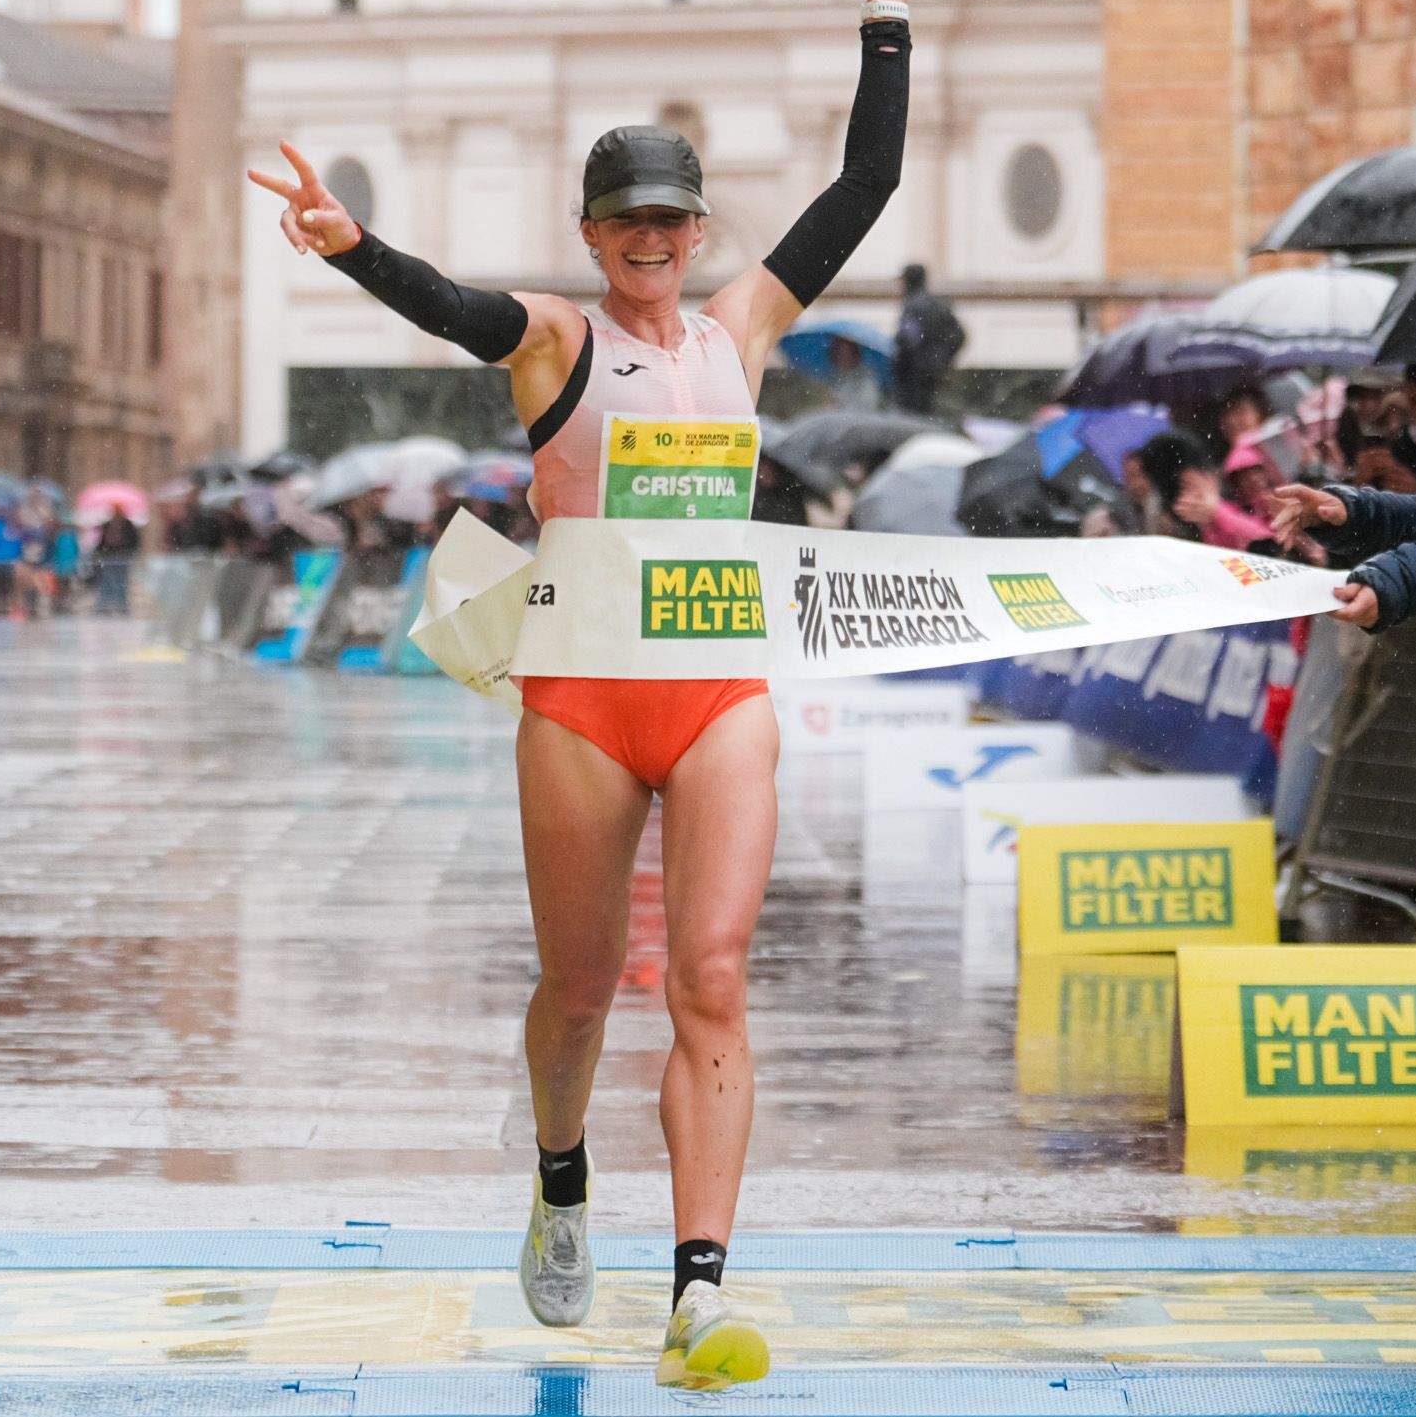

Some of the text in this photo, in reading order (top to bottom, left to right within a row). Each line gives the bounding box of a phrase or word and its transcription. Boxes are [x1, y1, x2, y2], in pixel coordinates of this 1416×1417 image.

[654, 432, 673, 447] 10
[632, 474, 737, 498] CRISTINA
[686, 503, 697, 518] 5
[651, 566, 760, 598] MANN
[825, 569, 966, 611] XIX MARATÓN
[991, 579, 1061, 605] MANN
[651, 600, 765, 632] FILTER
[831, 613, 992, 650] DE ZARAGOZA
[1008, 603, 1081, 630] FILTER
[1068, 855, 1224, 889] MANN
[1068, 889, 1227, 925] FILTER
